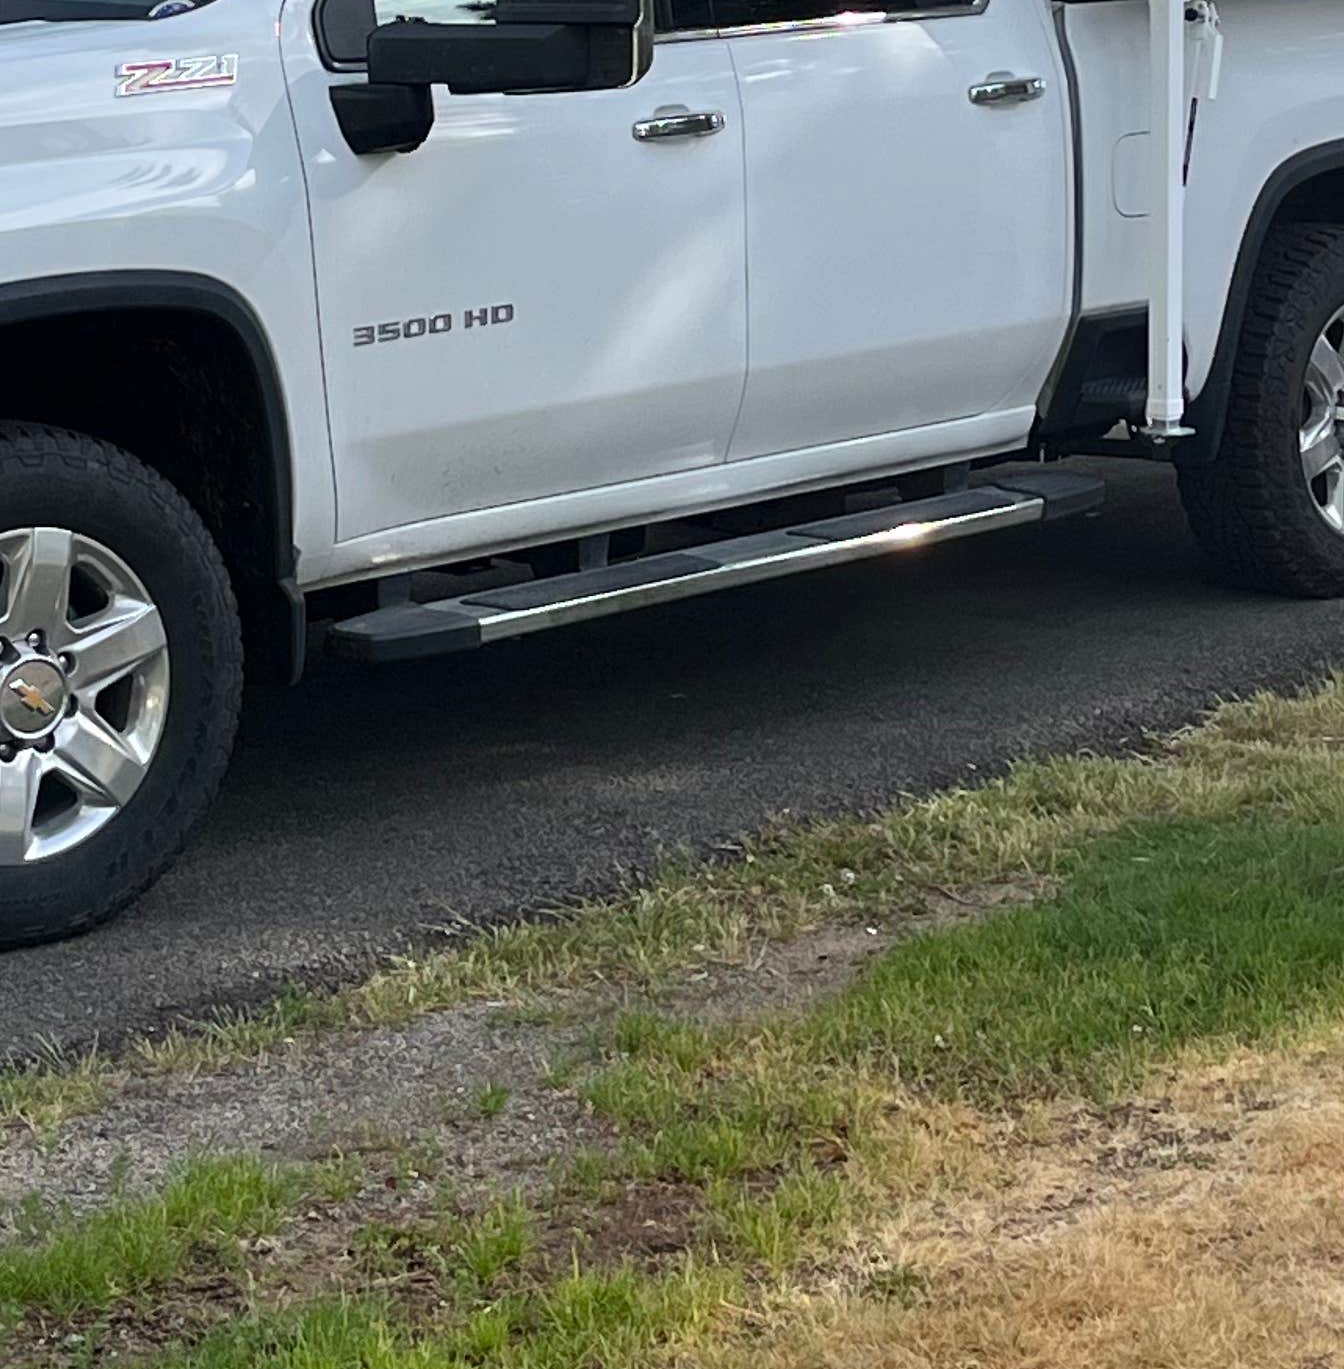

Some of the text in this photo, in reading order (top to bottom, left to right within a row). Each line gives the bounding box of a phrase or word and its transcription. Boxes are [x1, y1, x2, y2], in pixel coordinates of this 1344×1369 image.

[114, 53, 238, 97] Z71
[353, 303, 514, 347] 3500 HD
